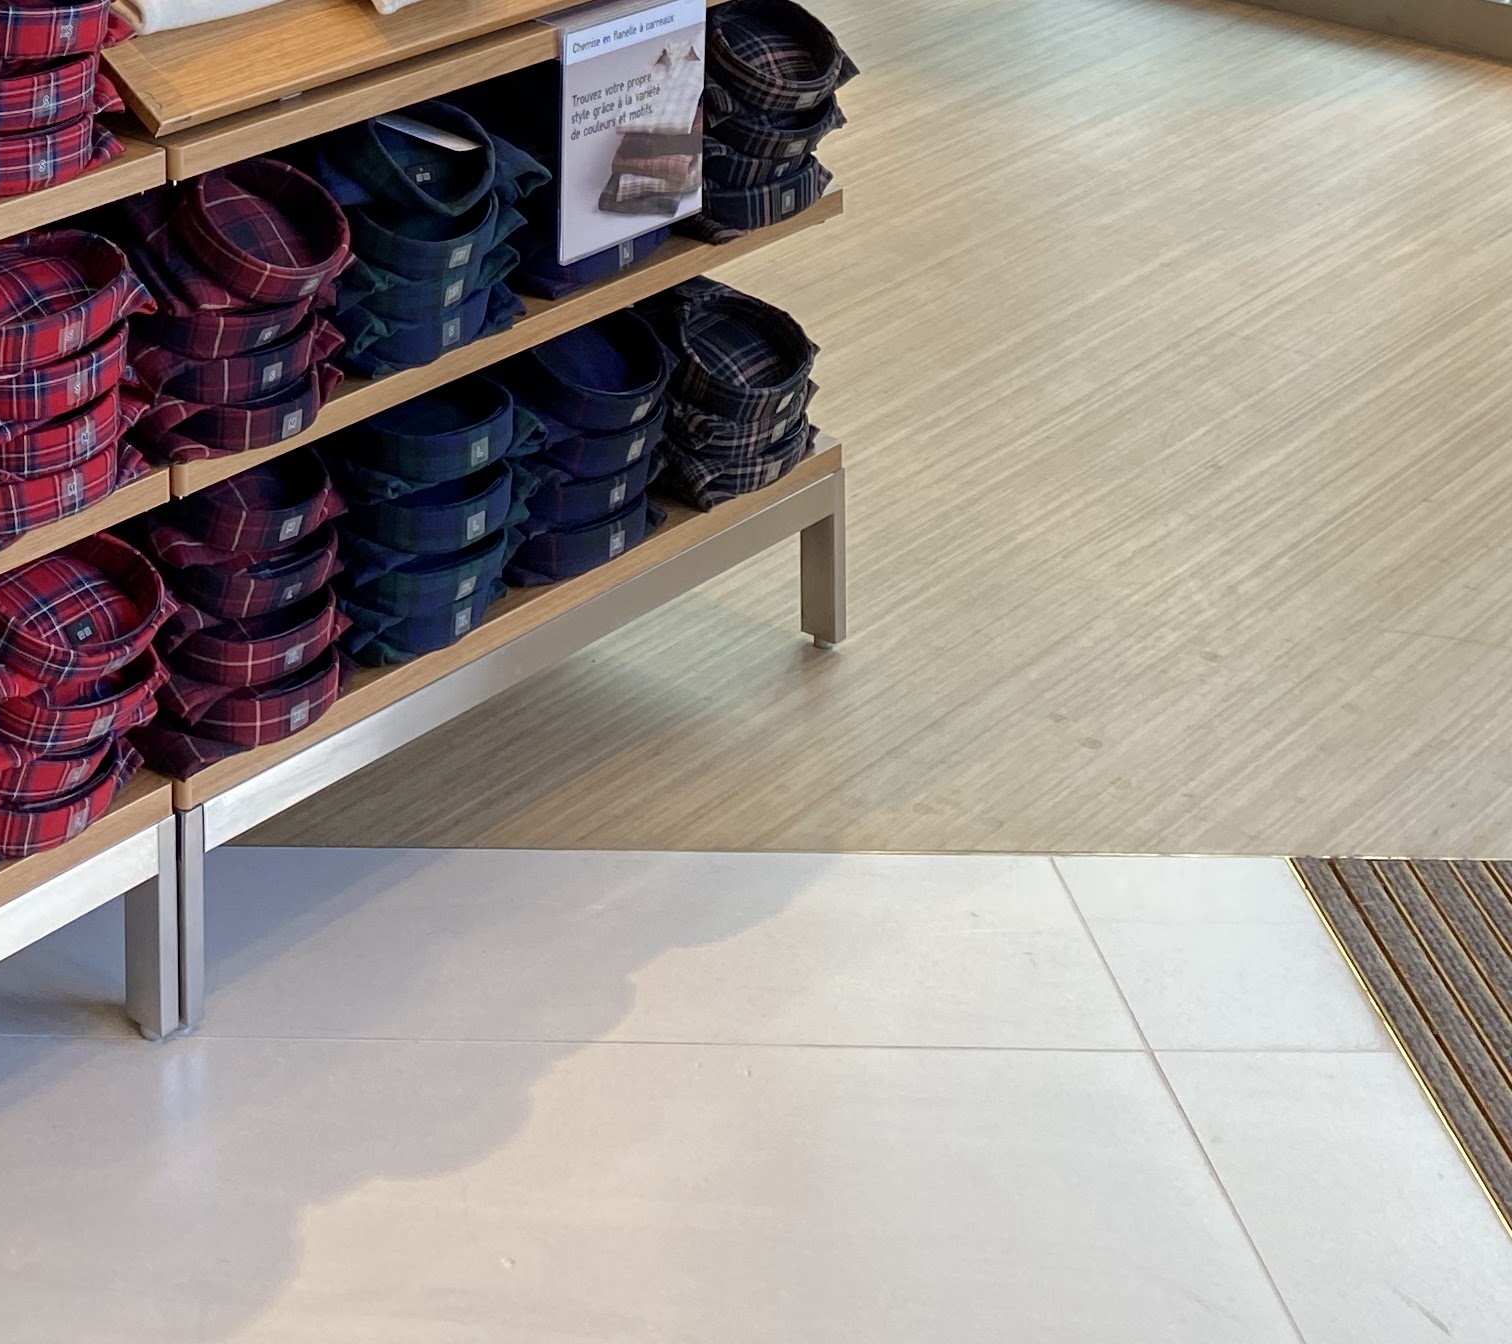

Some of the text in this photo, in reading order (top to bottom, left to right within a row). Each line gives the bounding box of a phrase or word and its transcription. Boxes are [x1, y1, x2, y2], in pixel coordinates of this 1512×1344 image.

[572, 37, 601, 54] Chemise
[602, 35, 611, 45] en
[645, 14, 675, 31] carreaux
[572, 73, 652, 107] Trouvez votre propre
[571, 109, 590, 125] style
[625, 93, 633, 106] la
[570, 128, 581, 141] de
[583, 118, 616, 136] couleurs
[618, 111, 626, 124] et
